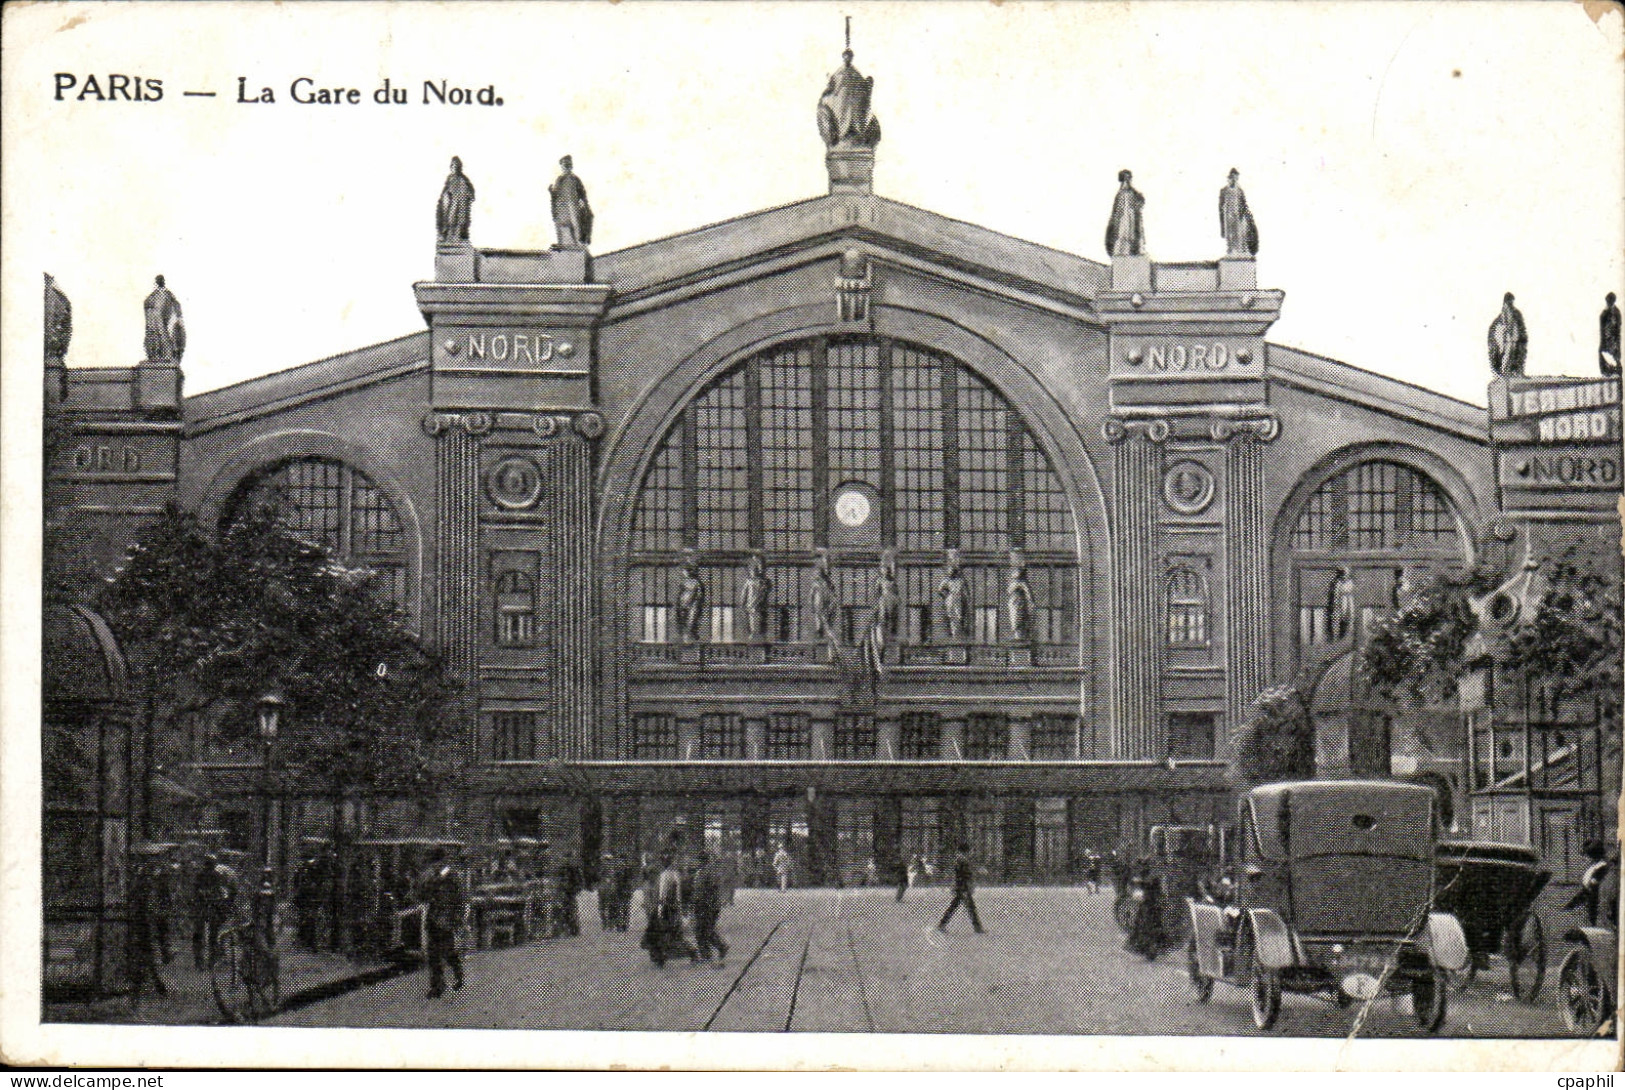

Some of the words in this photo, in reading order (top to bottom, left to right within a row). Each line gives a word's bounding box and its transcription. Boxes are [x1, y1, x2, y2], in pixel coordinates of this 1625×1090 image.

[54, 73, 164, 102] PARIS
[237, 76, 275, 104] La
[290, 77, 361, 105] Gare
[373, 78, 408, 104] du
[468, 333, 554, 365] NORD
[1149, 341, 1229, 372] NORD
[73, 444, 141, 474] ORD
[1532, 456, 1617, 484] NORD
